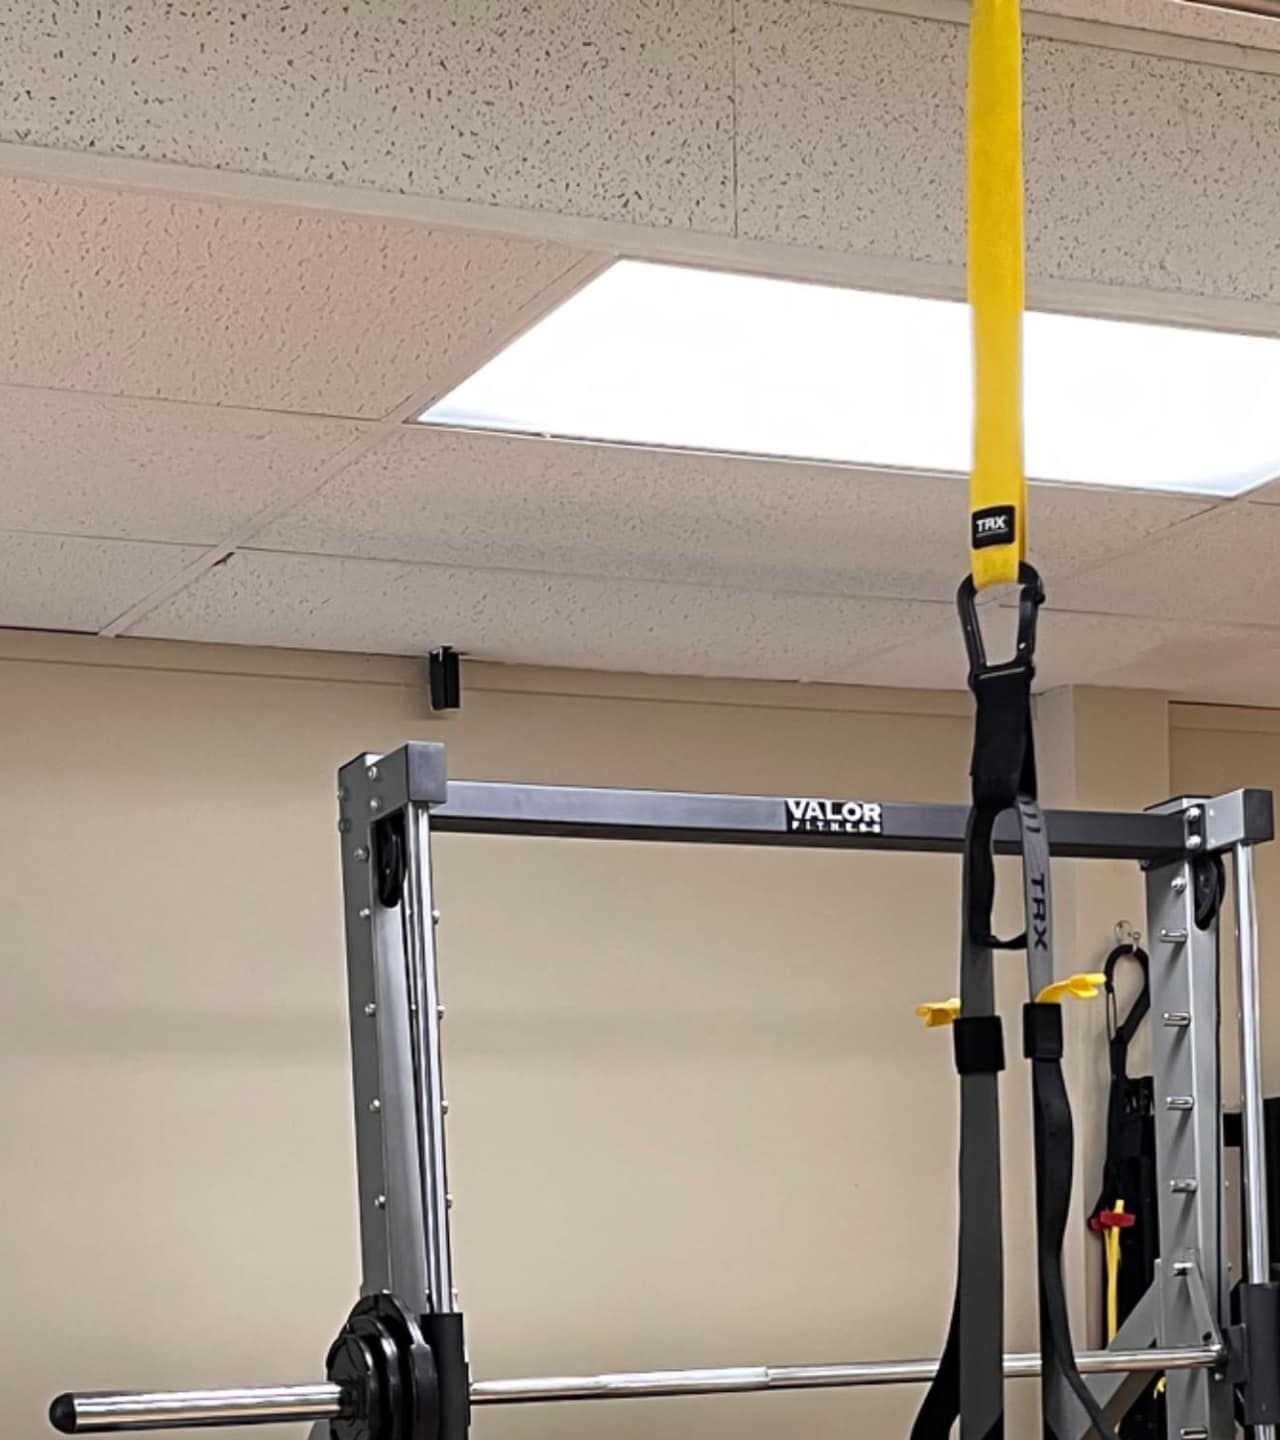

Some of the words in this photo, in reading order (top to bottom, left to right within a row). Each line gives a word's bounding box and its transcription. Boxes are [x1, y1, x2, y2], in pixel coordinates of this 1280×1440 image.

[975, 515, 1008, 532] TRX
[784, 800, 882, 822] VALOR
[1030, 873, 1048, 951] TRX
